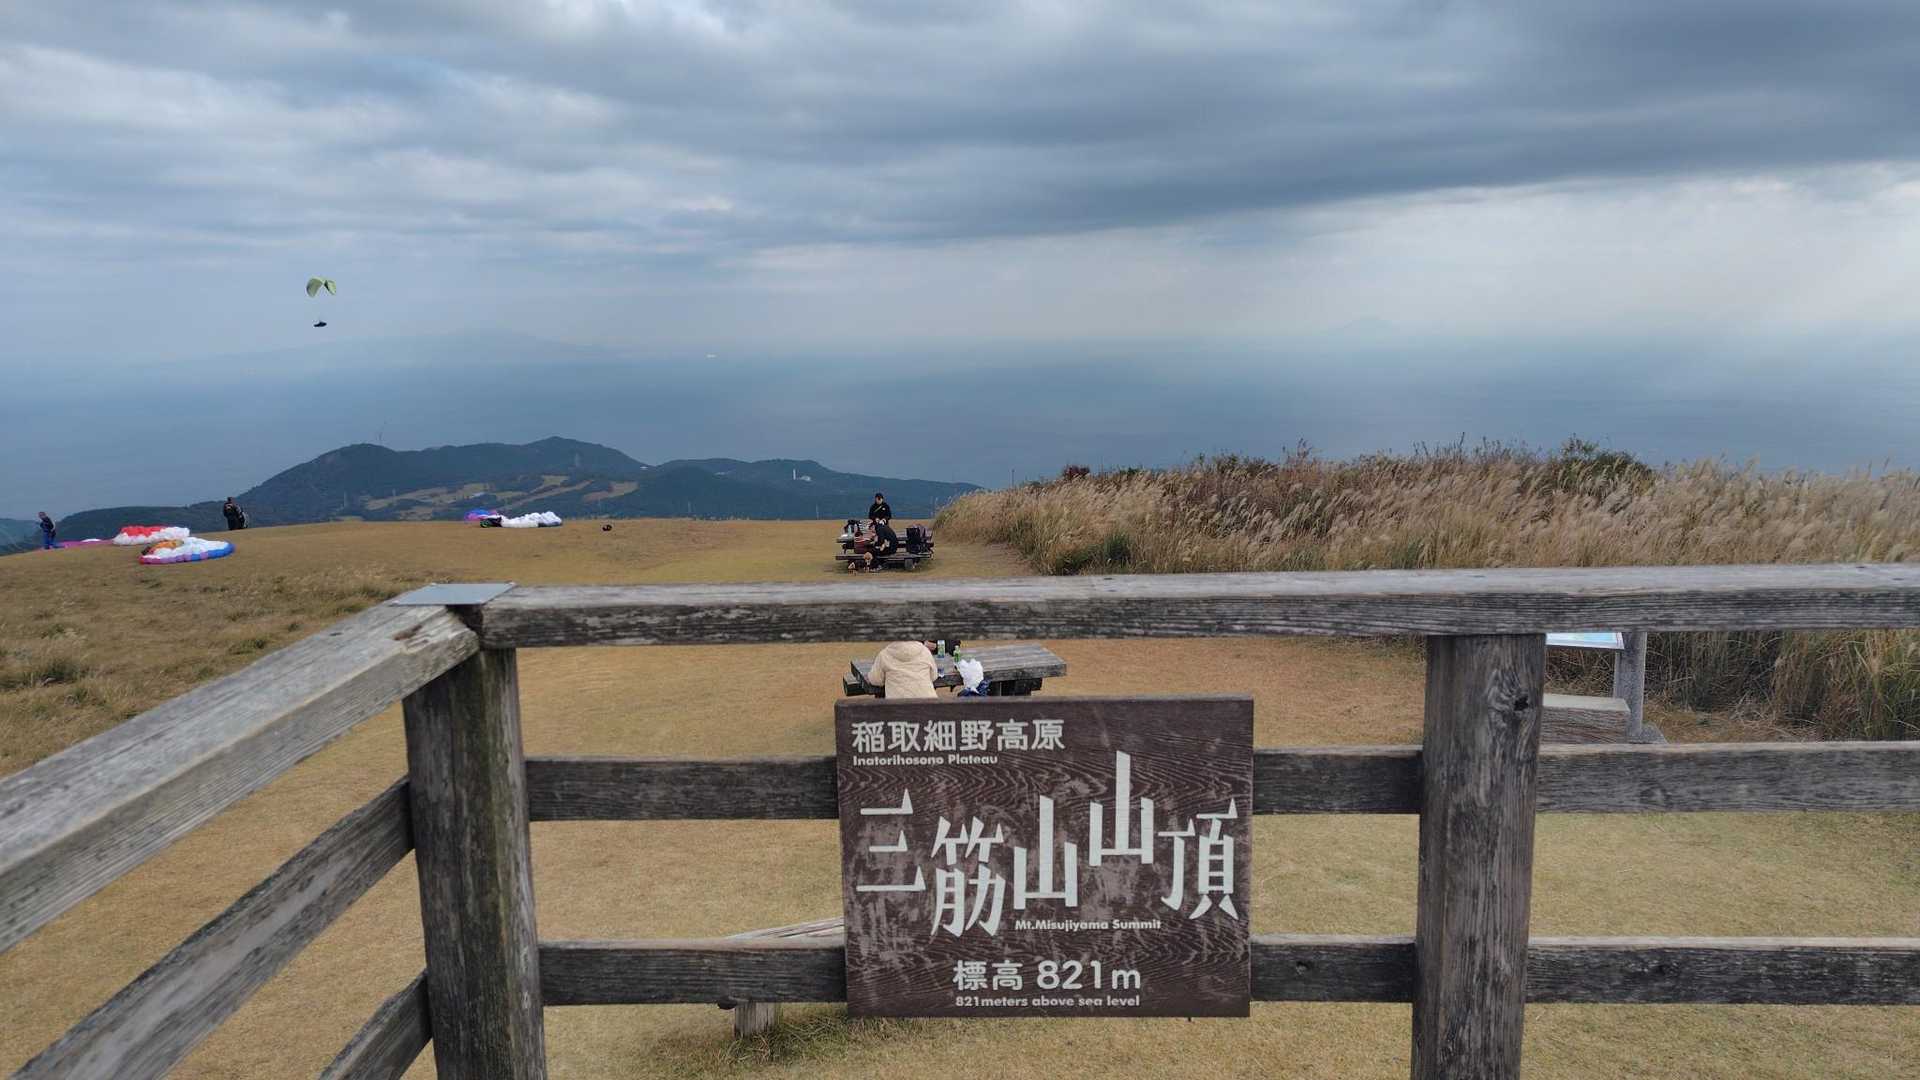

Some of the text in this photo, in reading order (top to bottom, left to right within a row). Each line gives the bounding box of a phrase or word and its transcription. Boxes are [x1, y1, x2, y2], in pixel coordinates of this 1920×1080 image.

[851, 719, 1065, 752] 稲取細野高原
[852, 754, 998, 767] Inatorihosono Plateau
[856, 750, 1239, 937] 三筋山山頂
[1112, 919, 1162, 931] Summit
[952, 960, 1141, 991] 標高 821m
[1032, 996, 1073, 1007] above
[1078, 998, 1103, 1007] sea
[1106, 995, 1140, 1007] level
